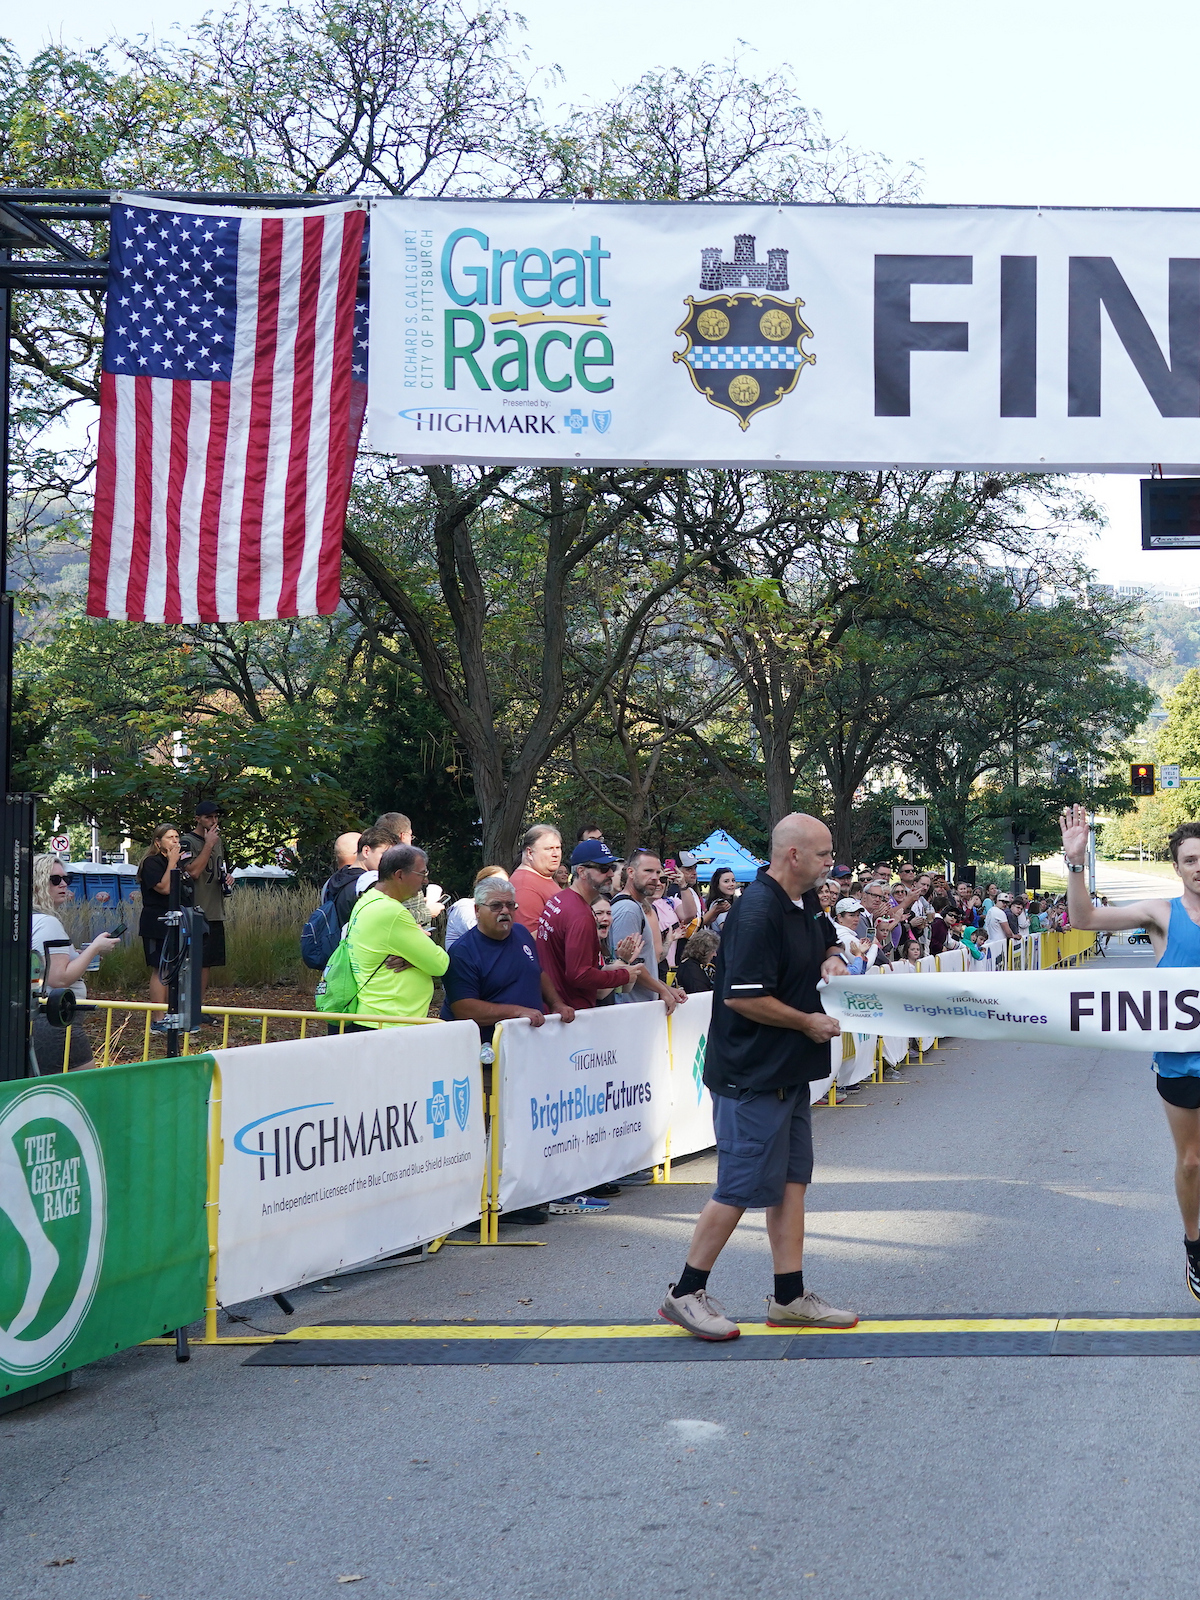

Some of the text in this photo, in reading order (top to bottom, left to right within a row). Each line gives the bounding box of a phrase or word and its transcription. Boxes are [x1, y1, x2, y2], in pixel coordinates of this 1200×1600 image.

[440, 227, 611, 308] Great
[404, 229, 418, 389] RICHARD S. CALIGUIRI
[420, 229, 434, 389] CITY OF PITTSBURGH
[444, 309, 614, 393] Race
[502, 399, 552, 409] Presented by:
[416, 412, 557, 434] HIGHMARK
[12, 914, 20, 942] Genie
[846, 998, 884, 1011] Race
[903, 1003, 1048, 1025] BrightBlueFutures
[952, 996, 1000, 1006] HIGHMARK
[573, 1049, 617, 1071] HIGHMARK
[530, 1079, 652, 1135] BrightBlueFutures
[24, 1132, 57, 1166] THE
[258, 1100, 419, 1182] HIGHMARK
[543, 1120, 642, 1158] community health resilience
[31, 1156, 81, 1196] GREAT
[261, 1150, 472, 1216] An Independent Licensee of the Blue Cross and Blue Shield Association
[42, 1186, 81, 1223] RACE
